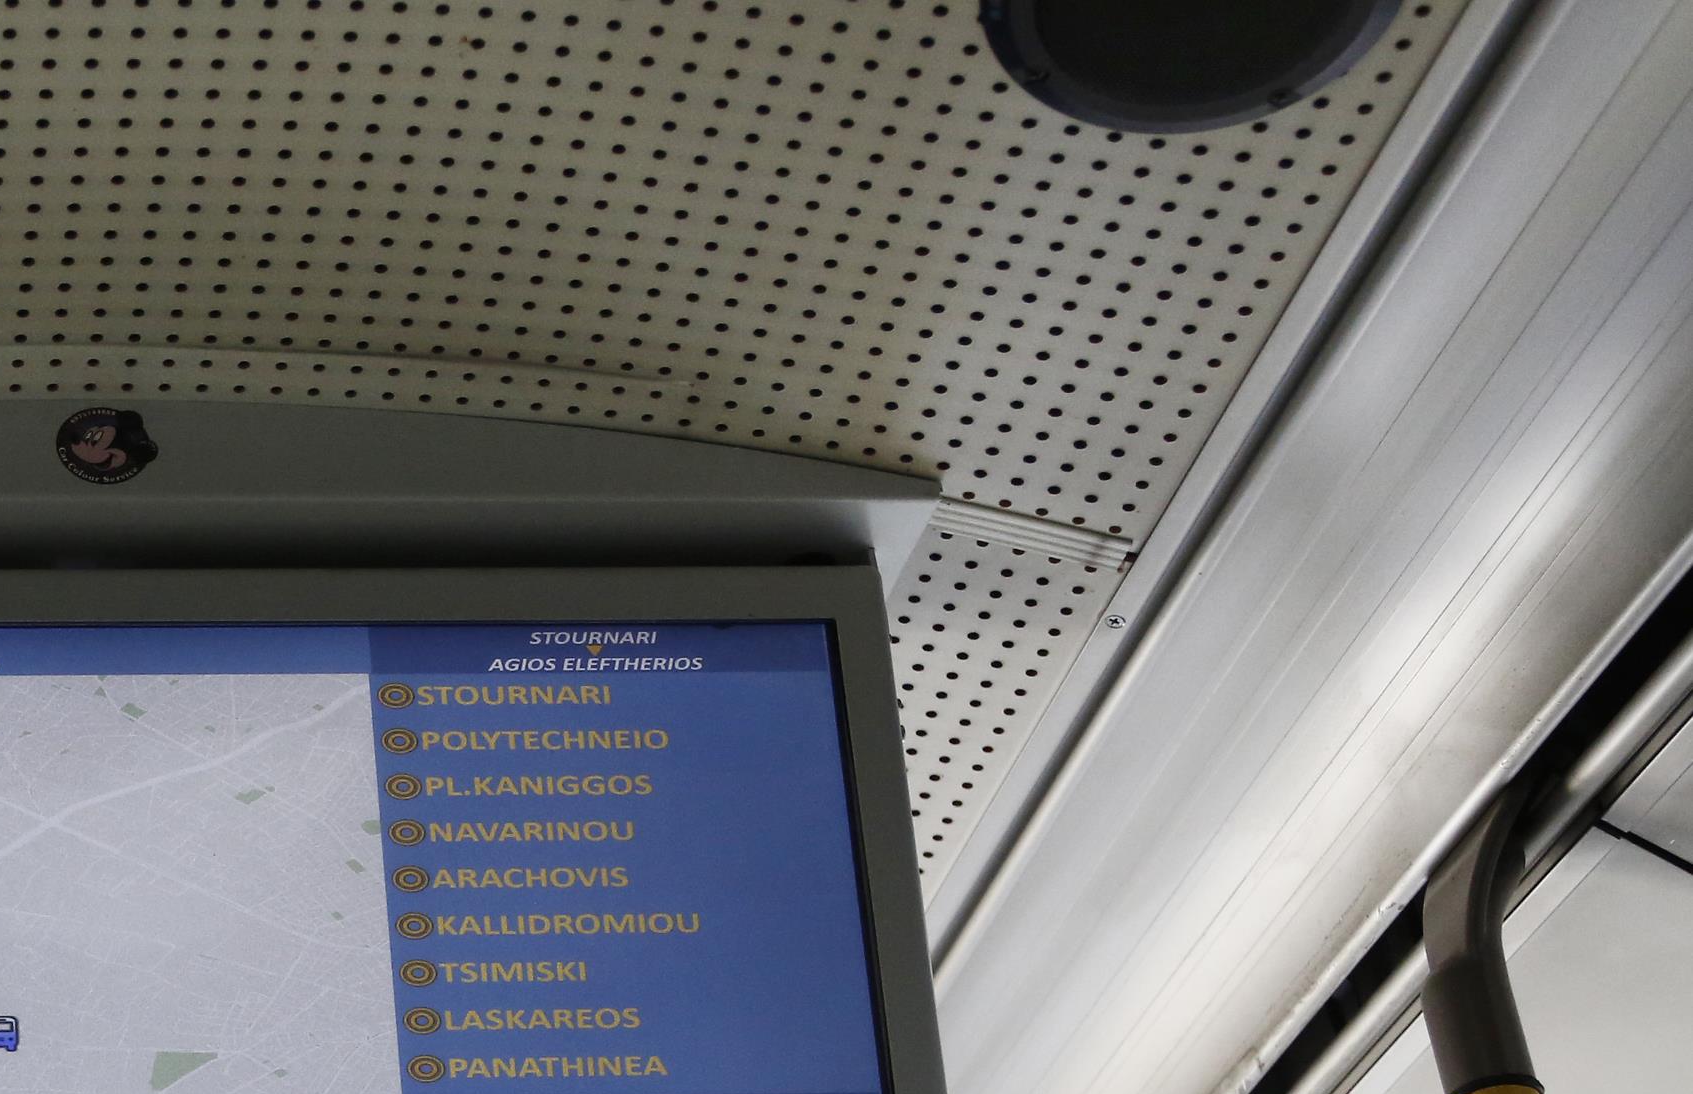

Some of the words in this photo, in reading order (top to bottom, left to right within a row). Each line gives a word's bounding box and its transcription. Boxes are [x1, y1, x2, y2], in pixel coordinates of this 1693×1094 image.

[529, 631, 657, 646] STOURNARI
[488, 657, 556, 672] AGIOS
[561, 655, 704, 672] ELEFTHERIOS
[417, 685, 611, 706] STOURNARI
[422, 729, 669, 751] POLYTECHNEIO
[425, 774, 653, 797] PL.KANIGGOS
[429, 820, 635, 842] NAVARINOU
[433, 866, 629, 889] ARACHOVIS
[436, 913, 700, 936] KALLIDROMIOU
[439, 961, 588, 983] TSIMISKI
[444, 1008, 641, 1032] LASKAREOS
[449, 1055, 668, 1079] PANATHINEA
